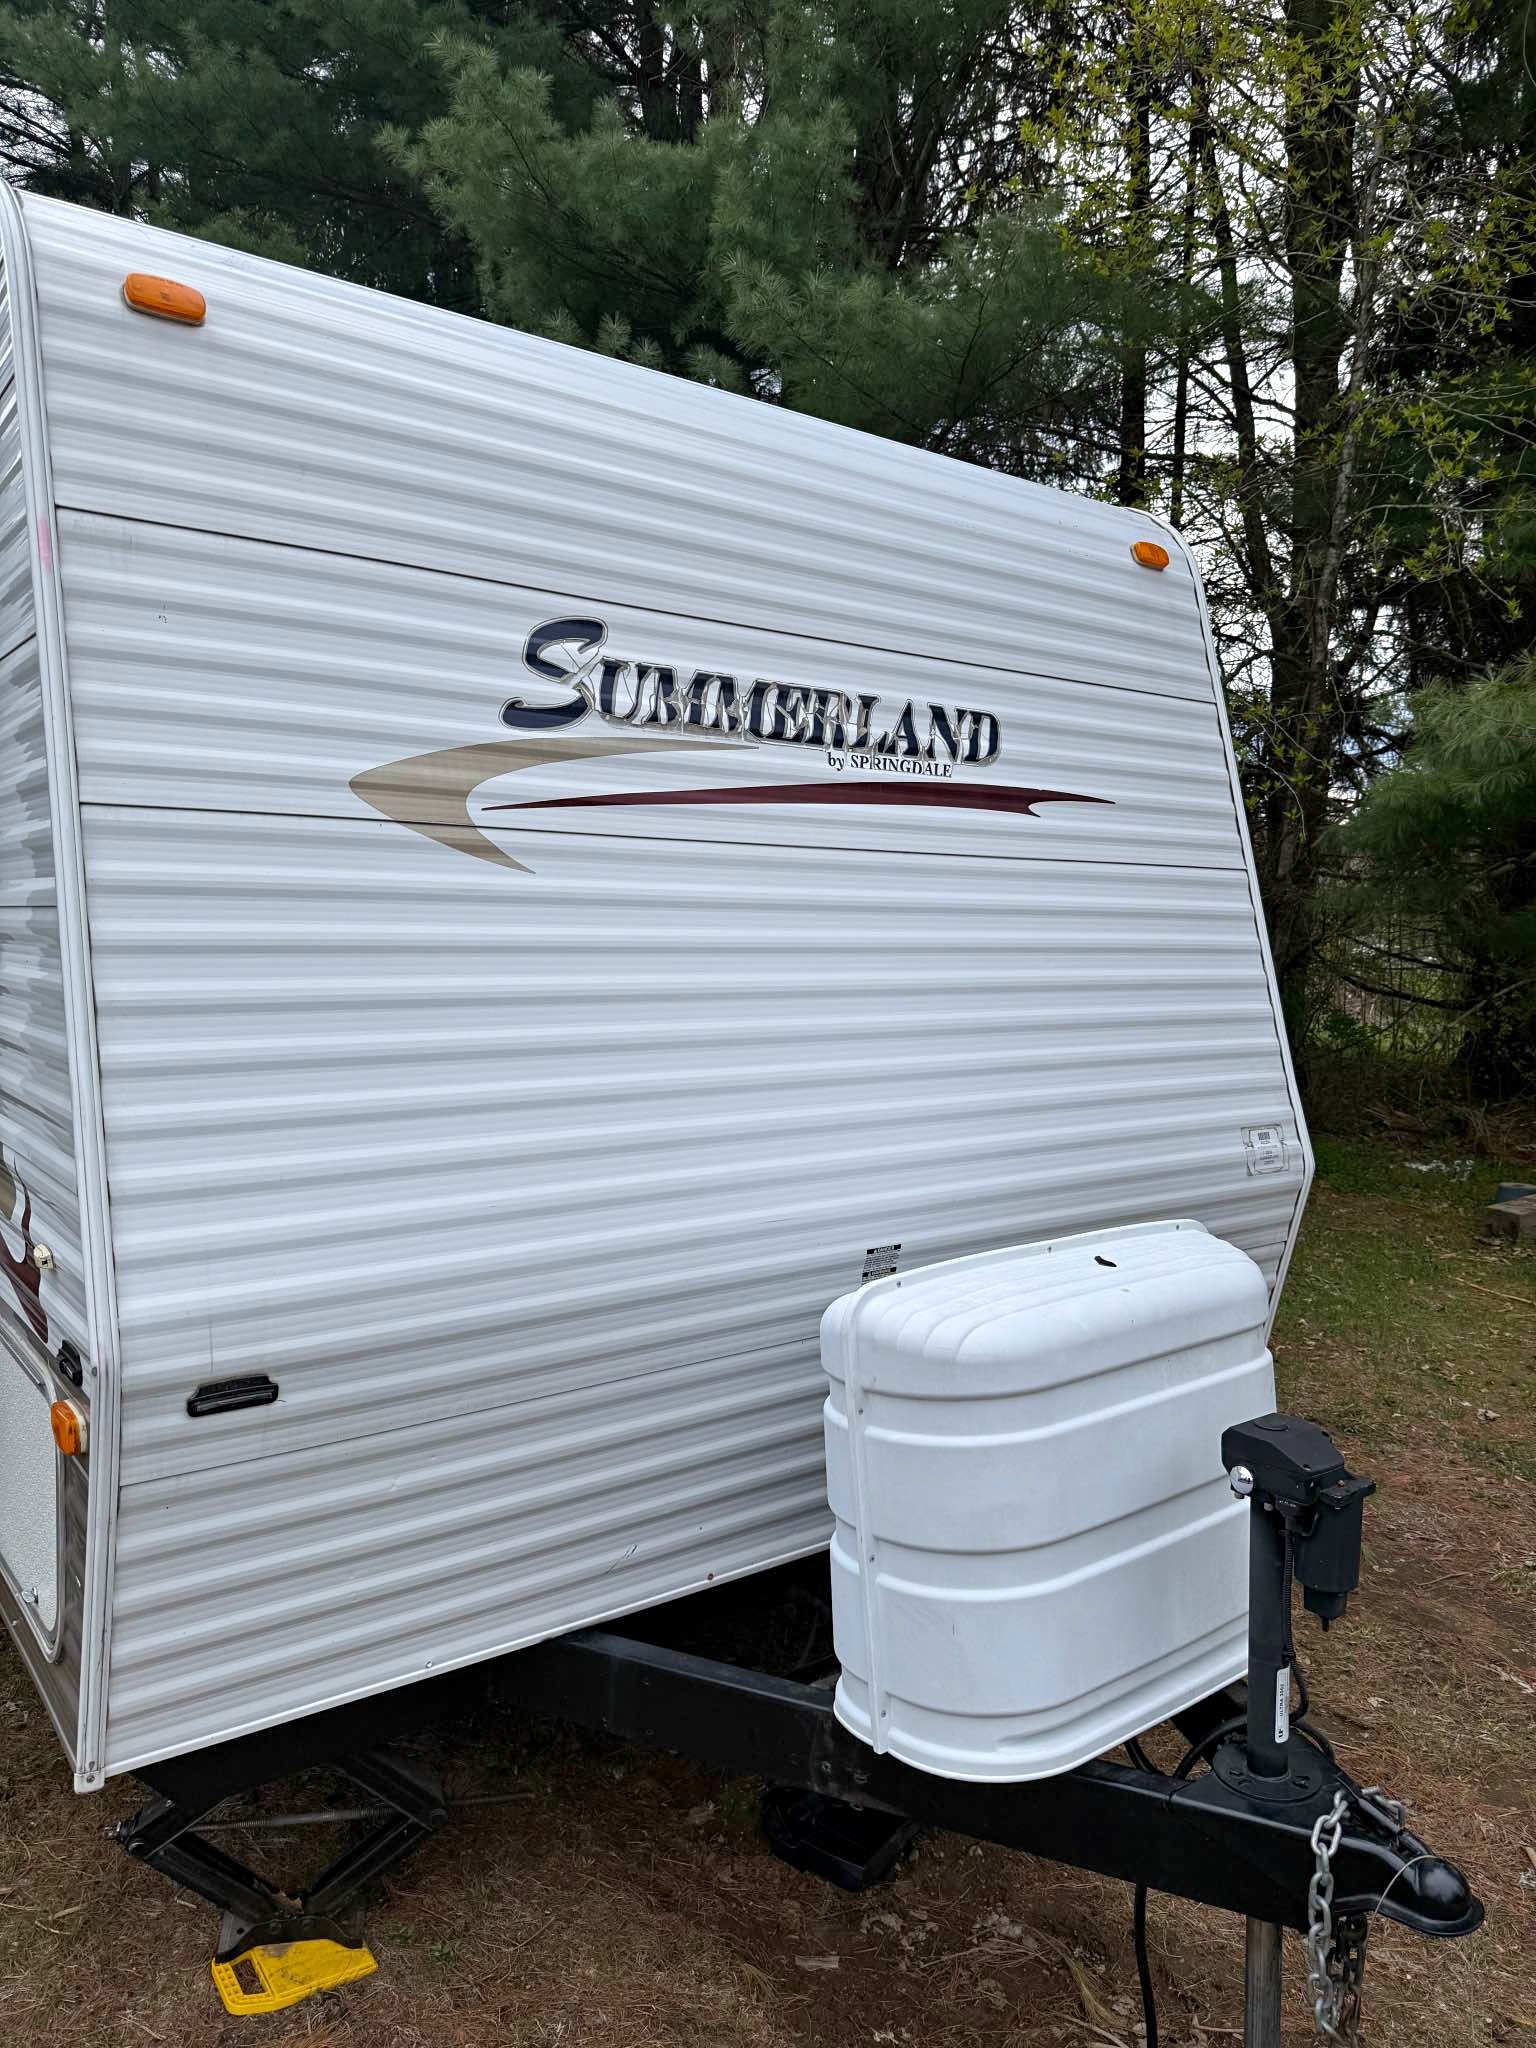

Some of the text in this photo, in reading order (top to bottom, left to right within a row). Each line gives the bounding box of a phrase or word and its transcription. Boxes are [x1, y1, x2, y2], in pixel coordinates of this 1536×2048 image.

[499, 615, 1002, 767] SUMMERLAND
[827, 751, 953, 778] by SPRINGDALE
